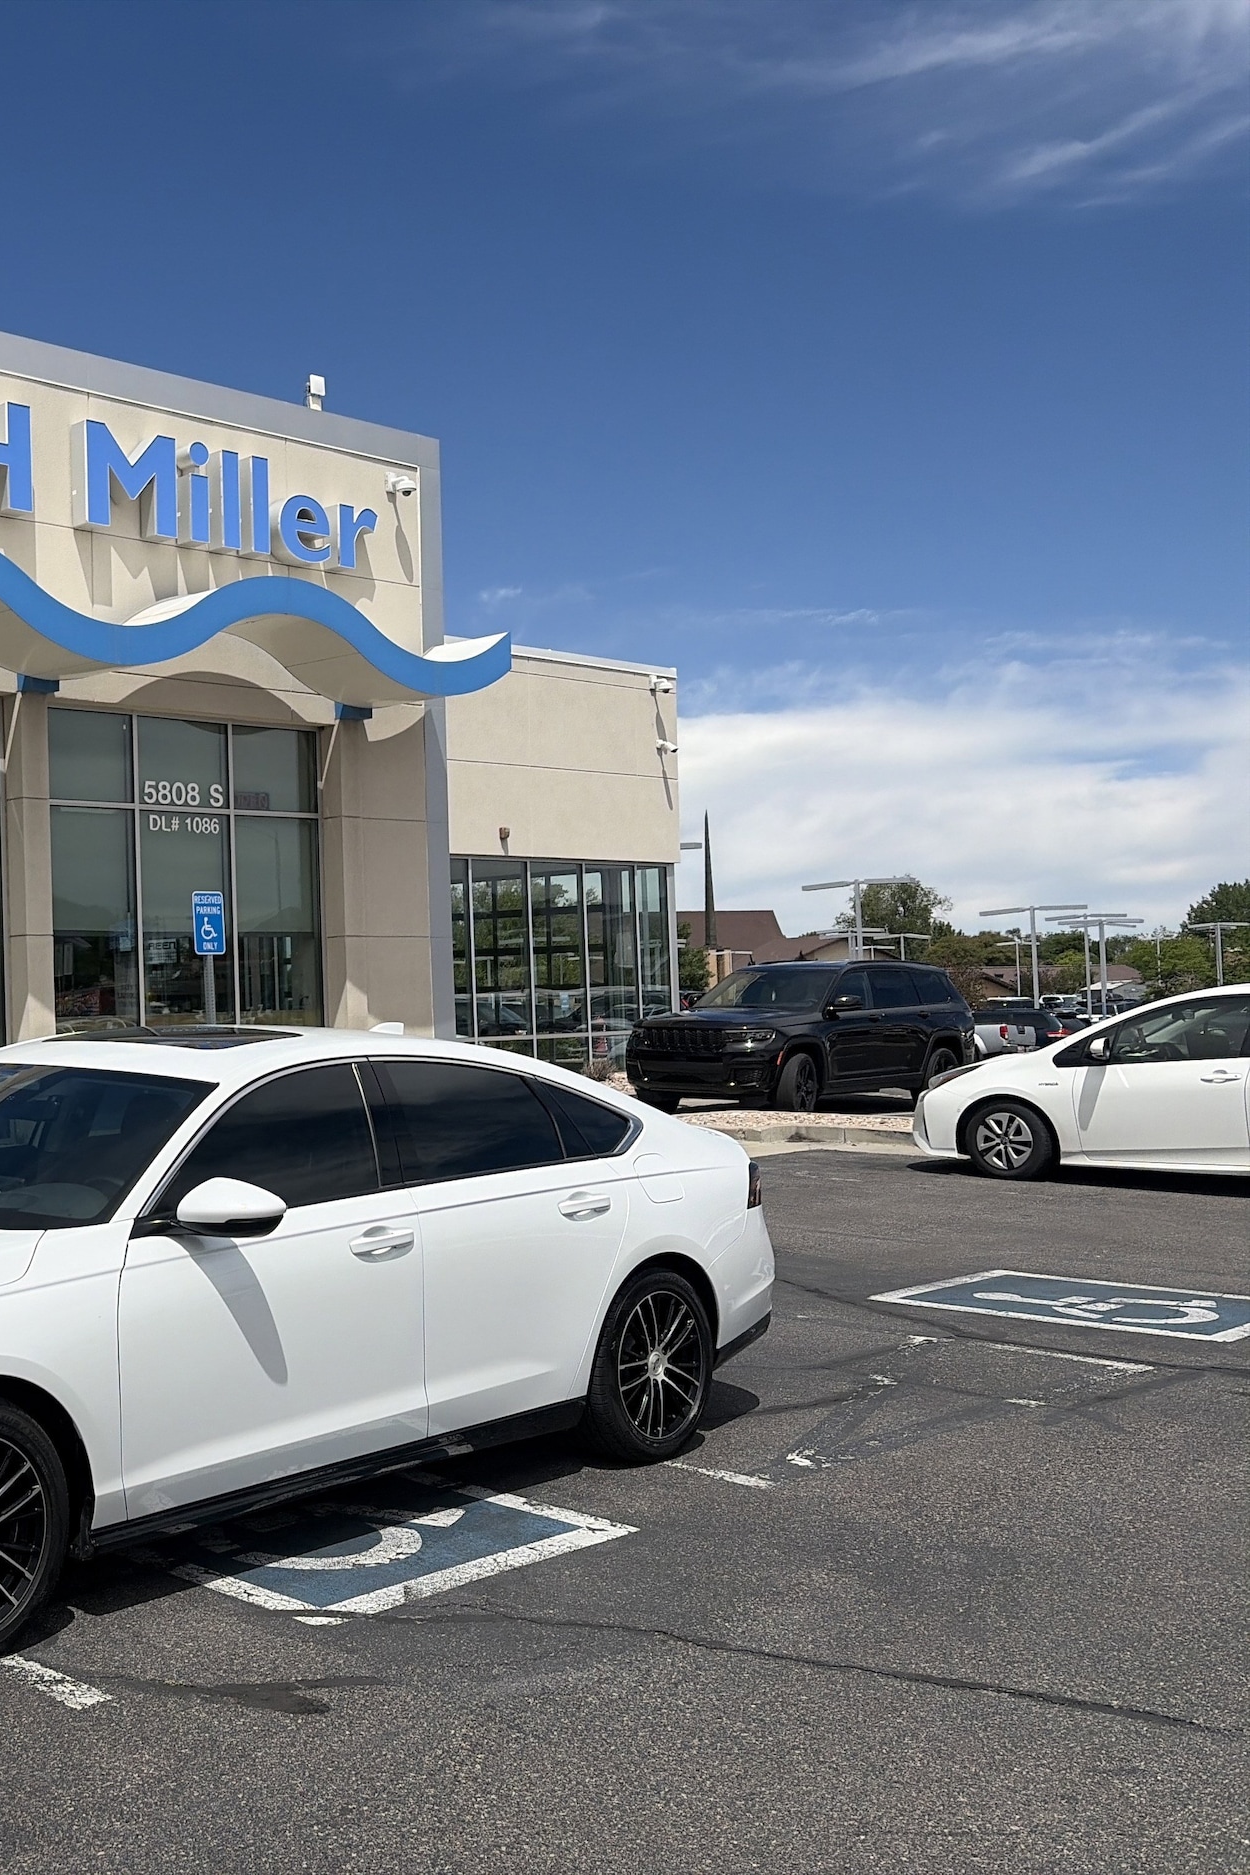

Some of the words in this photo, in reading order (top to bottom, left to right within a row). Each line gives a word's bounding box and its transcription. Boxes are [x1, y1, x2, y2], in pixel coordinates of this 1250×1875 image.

[80, 418, 379, 570] Miller
[143, 780, 201, 806] 5808
[209, 783, 224, 808] S
[148, 814, 180, 832] DL#
[185, 816, 220, 834] 1086
[194, 895, 222, 904] RESERVED
[195, 905, 221, 915] PARKING
[202, 941, 218, 950] ONLY
